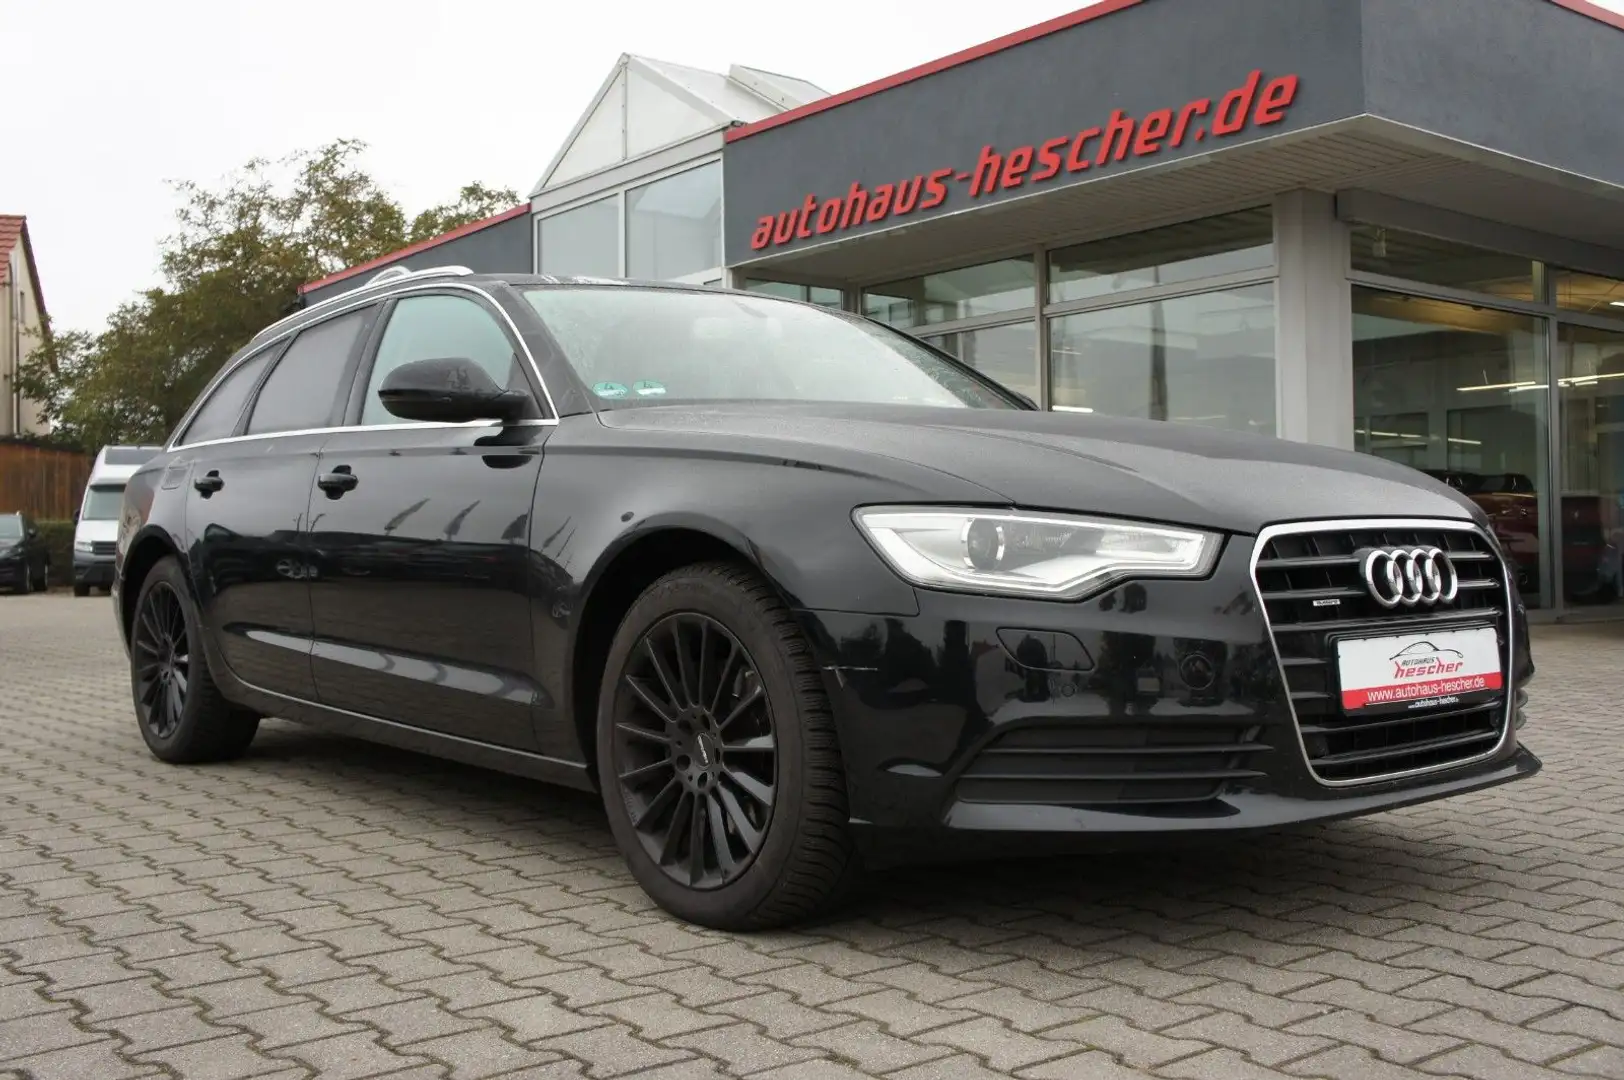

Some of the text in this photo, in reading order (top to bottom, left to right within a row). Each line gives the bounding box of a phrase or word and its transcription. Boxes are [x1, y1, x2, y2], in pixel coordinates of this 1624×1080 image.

[751, 69, 1299, 250] autohaus-hescher.de
[1394, 656, 1464, 679] hescher
[1401, 656, 1436, 667] AUTOHAUS
[1366, 675, 1486, 702] www.autohaus-hescher.de
